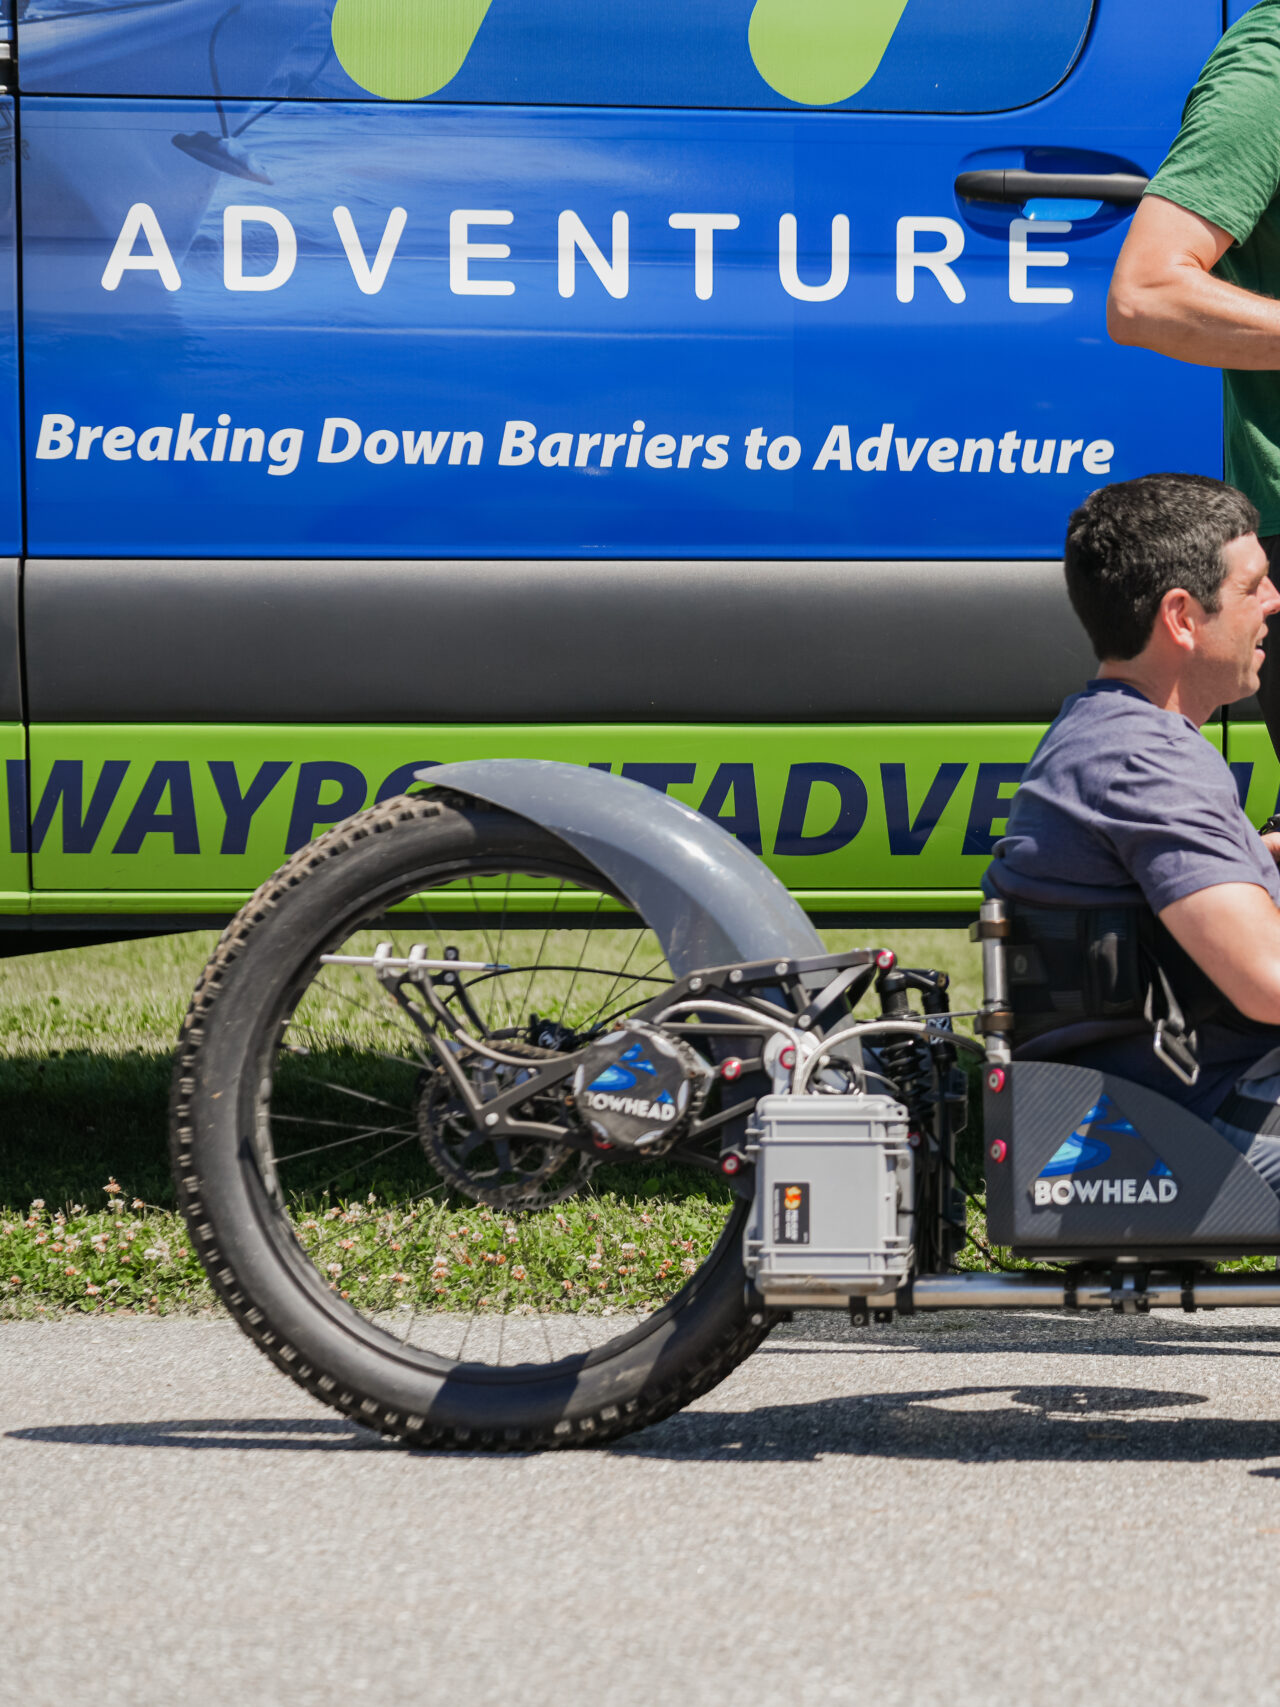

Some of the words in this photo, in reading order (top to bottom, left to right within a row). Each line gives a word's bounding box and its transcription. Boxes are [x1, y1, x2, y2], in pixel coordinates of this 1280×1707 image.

[101, 203, 1073, 304] ADVENTURE
[35, 413, 304, 476] Breaking
[317, 417, 484, 466] Down
[498, 419, 730, 470] Barriers
[744, 427, 802, 471] to
[812, 423, 1115, 475] Adventure
[1034, 1178, 1178, 1206] BOWHEAD
